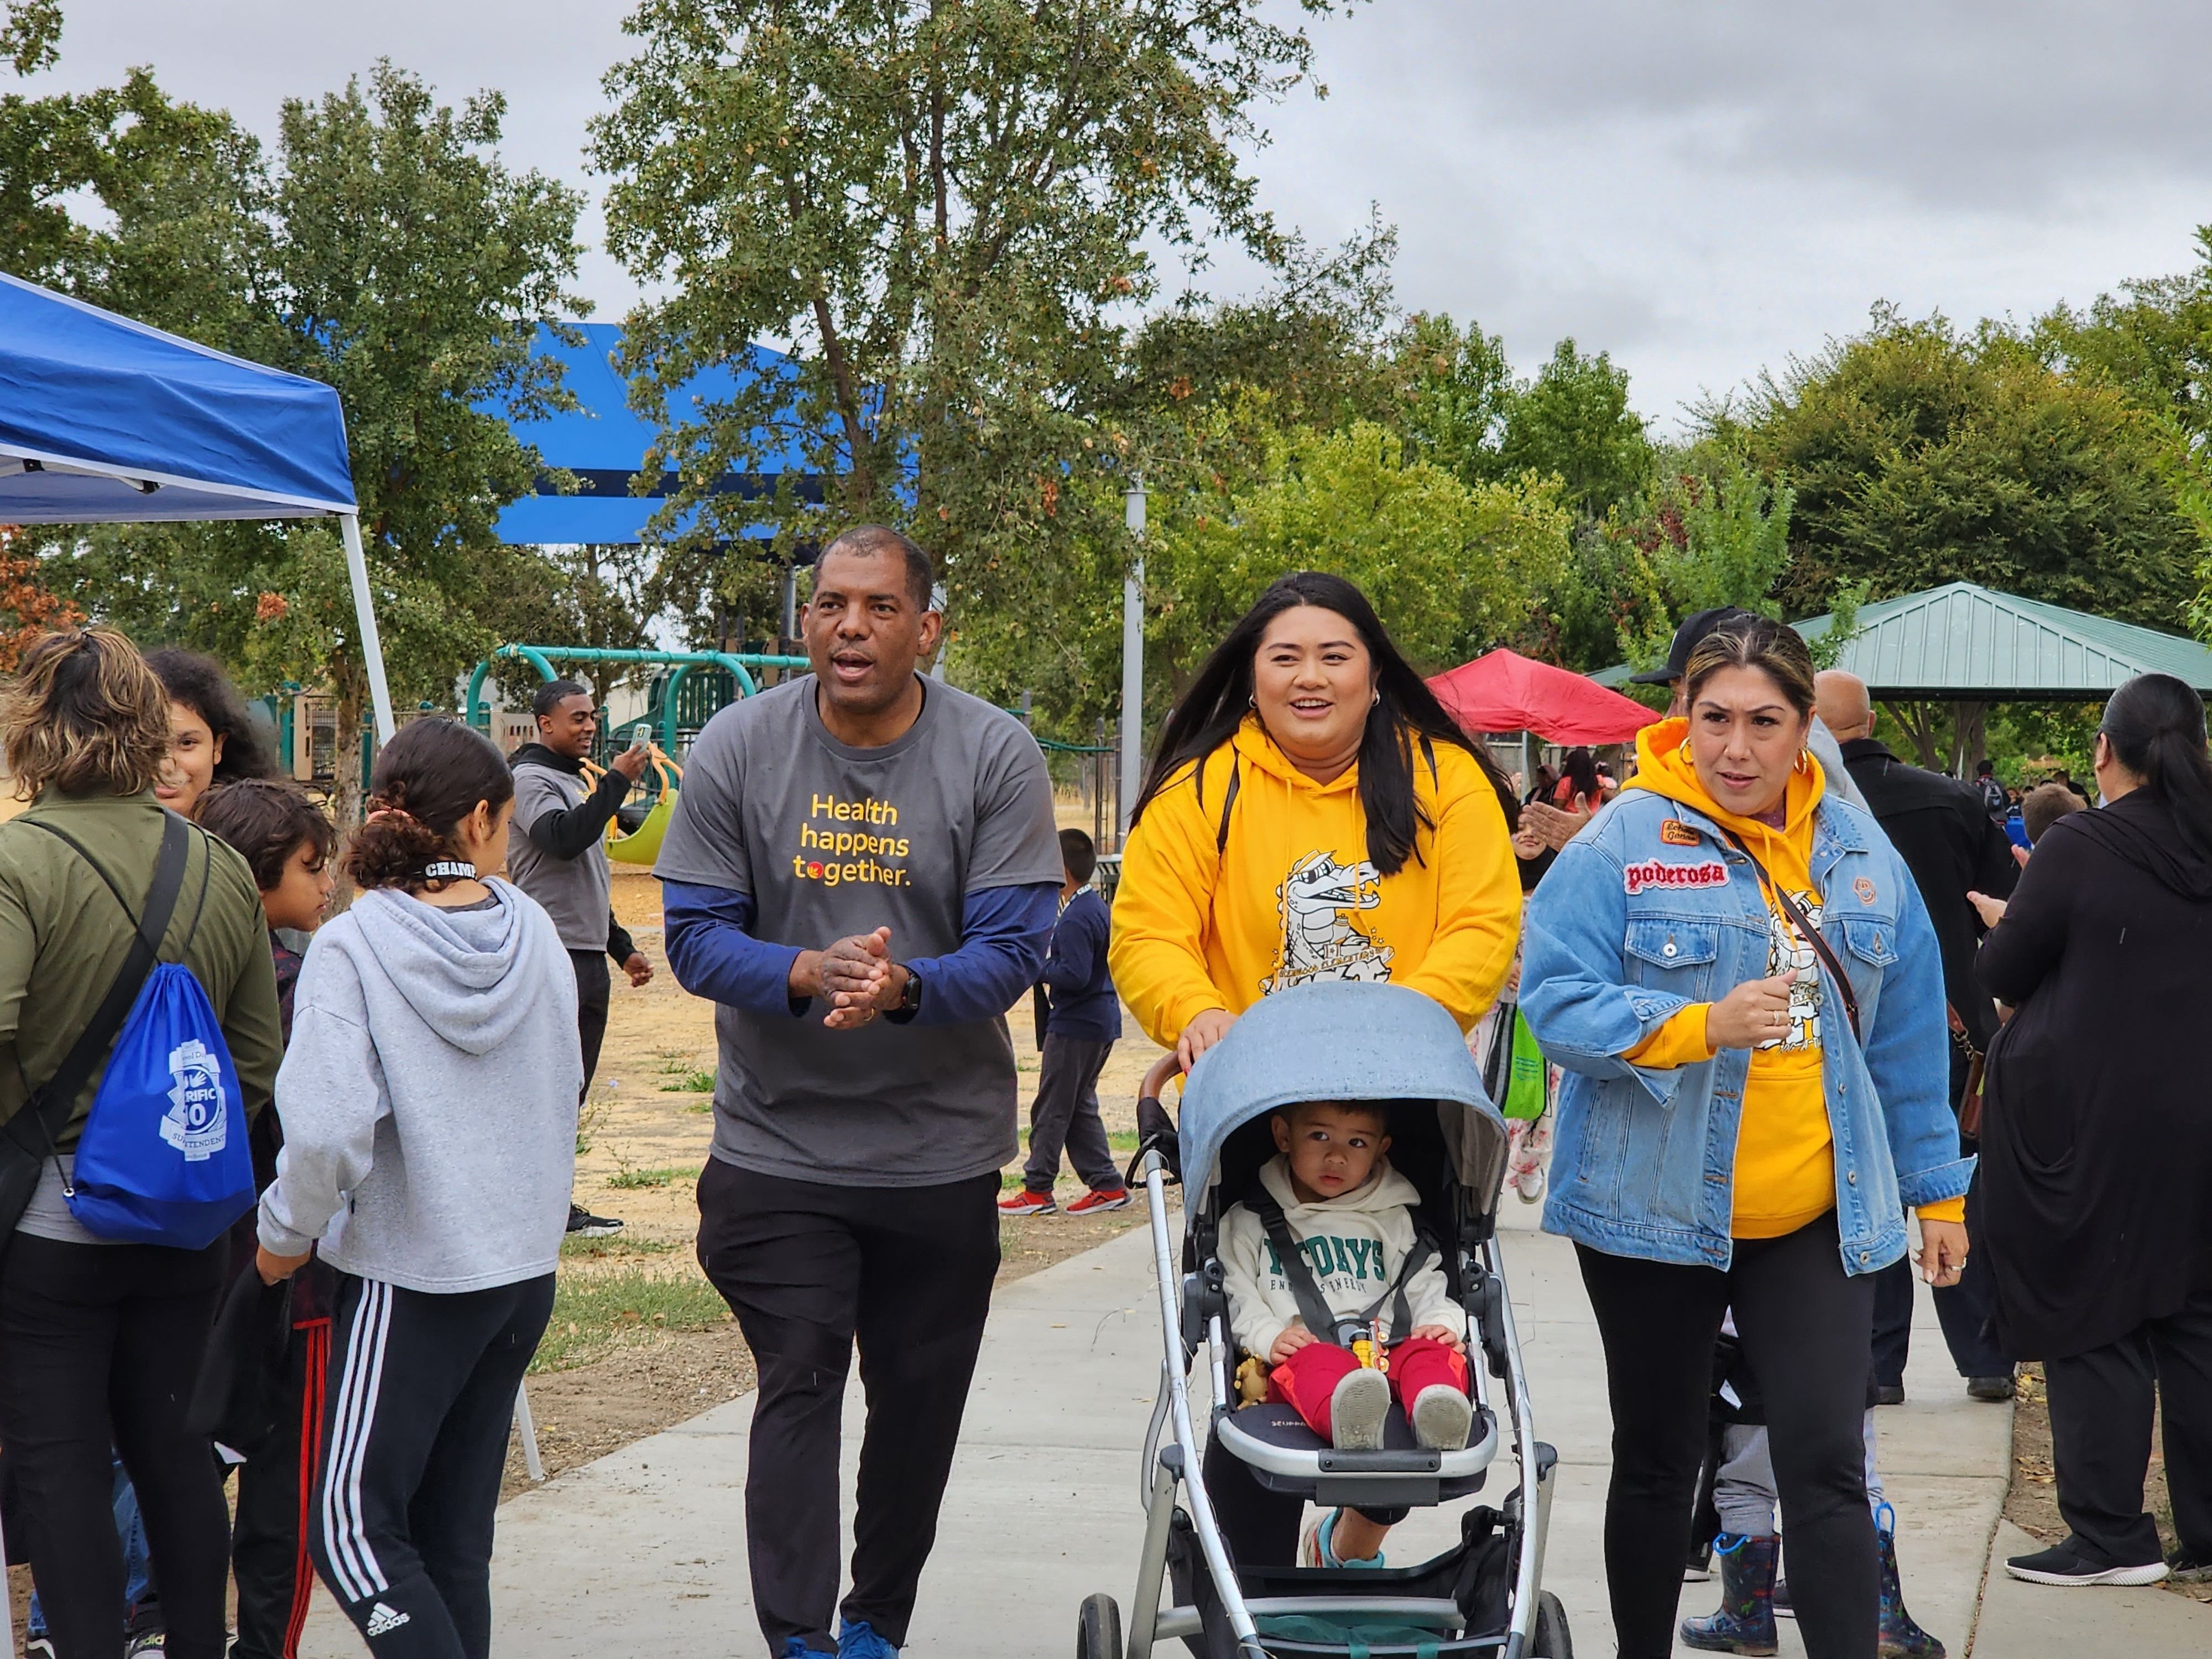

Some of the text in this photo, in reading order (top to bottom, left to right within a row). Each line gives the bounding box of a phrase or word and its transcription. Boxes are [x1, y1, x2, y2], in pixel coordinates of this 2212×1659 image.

[812, 794, 898, 826] Health
[801, 822, 910, 857] happens
[793, 855, 911, 886] together.
[1627, 862, 1725, 890] poderosa
[367, 1612, 411, 1637] adidas
